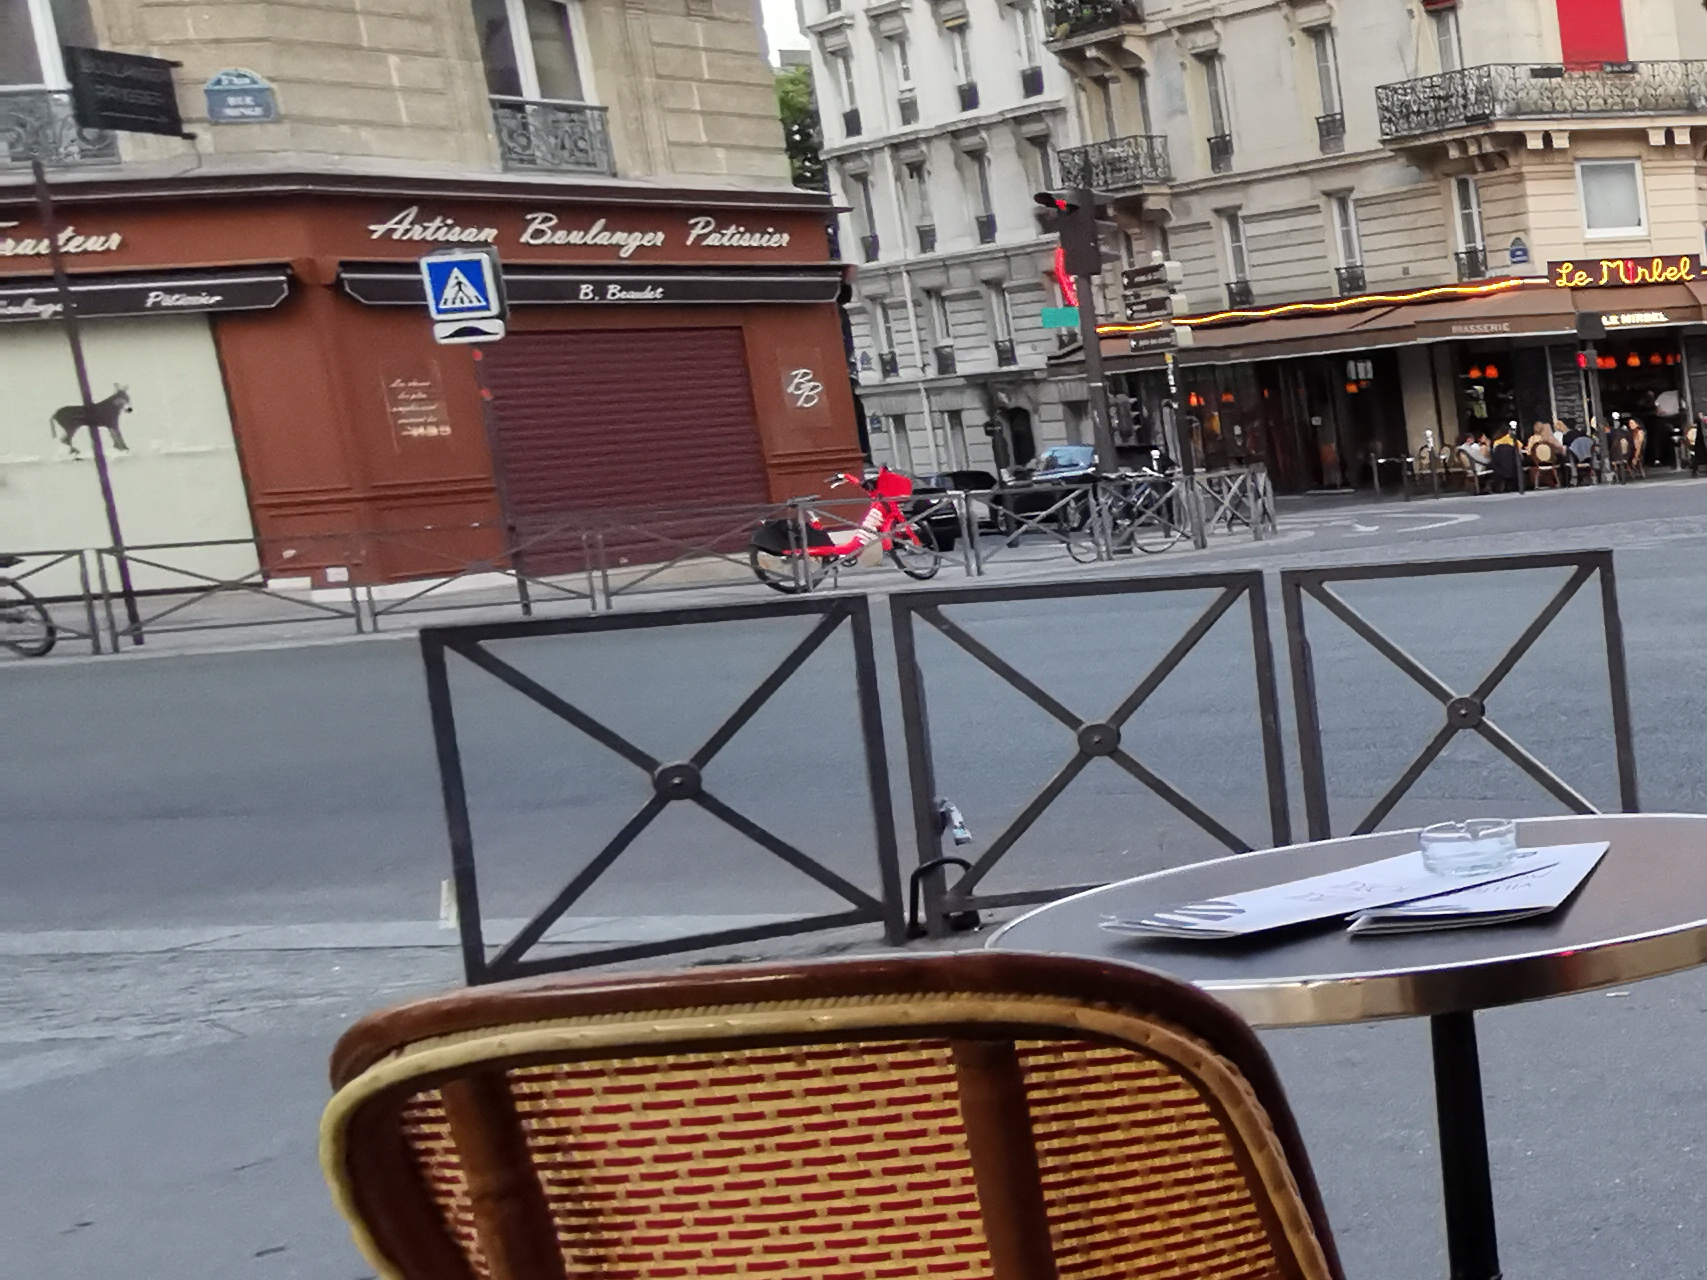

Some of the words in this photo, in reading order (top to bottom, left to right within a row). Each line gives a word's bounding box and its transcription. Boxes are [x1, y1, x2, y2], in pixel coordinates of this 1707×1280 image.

[367, 206, 499, 243] Artisan
[519, 211, 666, 258] Boulanger
[685, 216, 791, 248] Patissier
[1555, 262, 1593, 288] Le
[579, 283, 600, 301] B.
[1451, 322, 1511, 334] BRASSERIE
